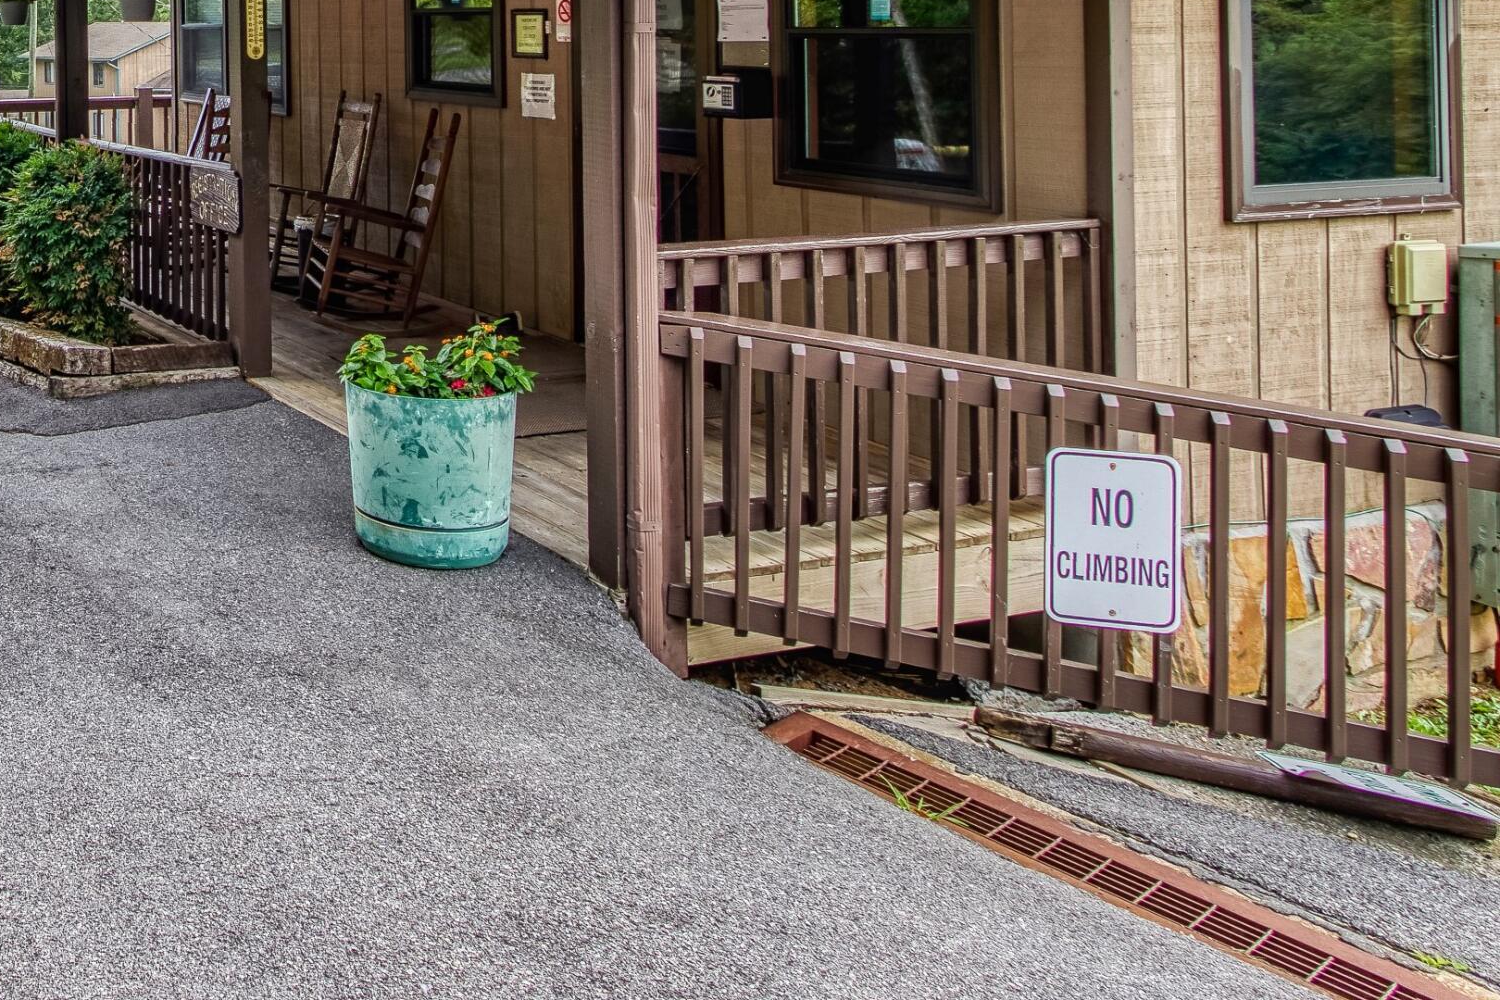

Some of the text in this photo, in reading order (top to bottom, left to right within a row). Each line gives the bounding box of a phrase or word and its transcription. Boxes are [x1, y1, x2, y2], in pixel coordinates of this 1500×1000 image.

[199, 201, 229, 224] OFFICE
[1091, 487, 1134, 528] NO
[1056, 550, 1170, 589] CLIMBING
